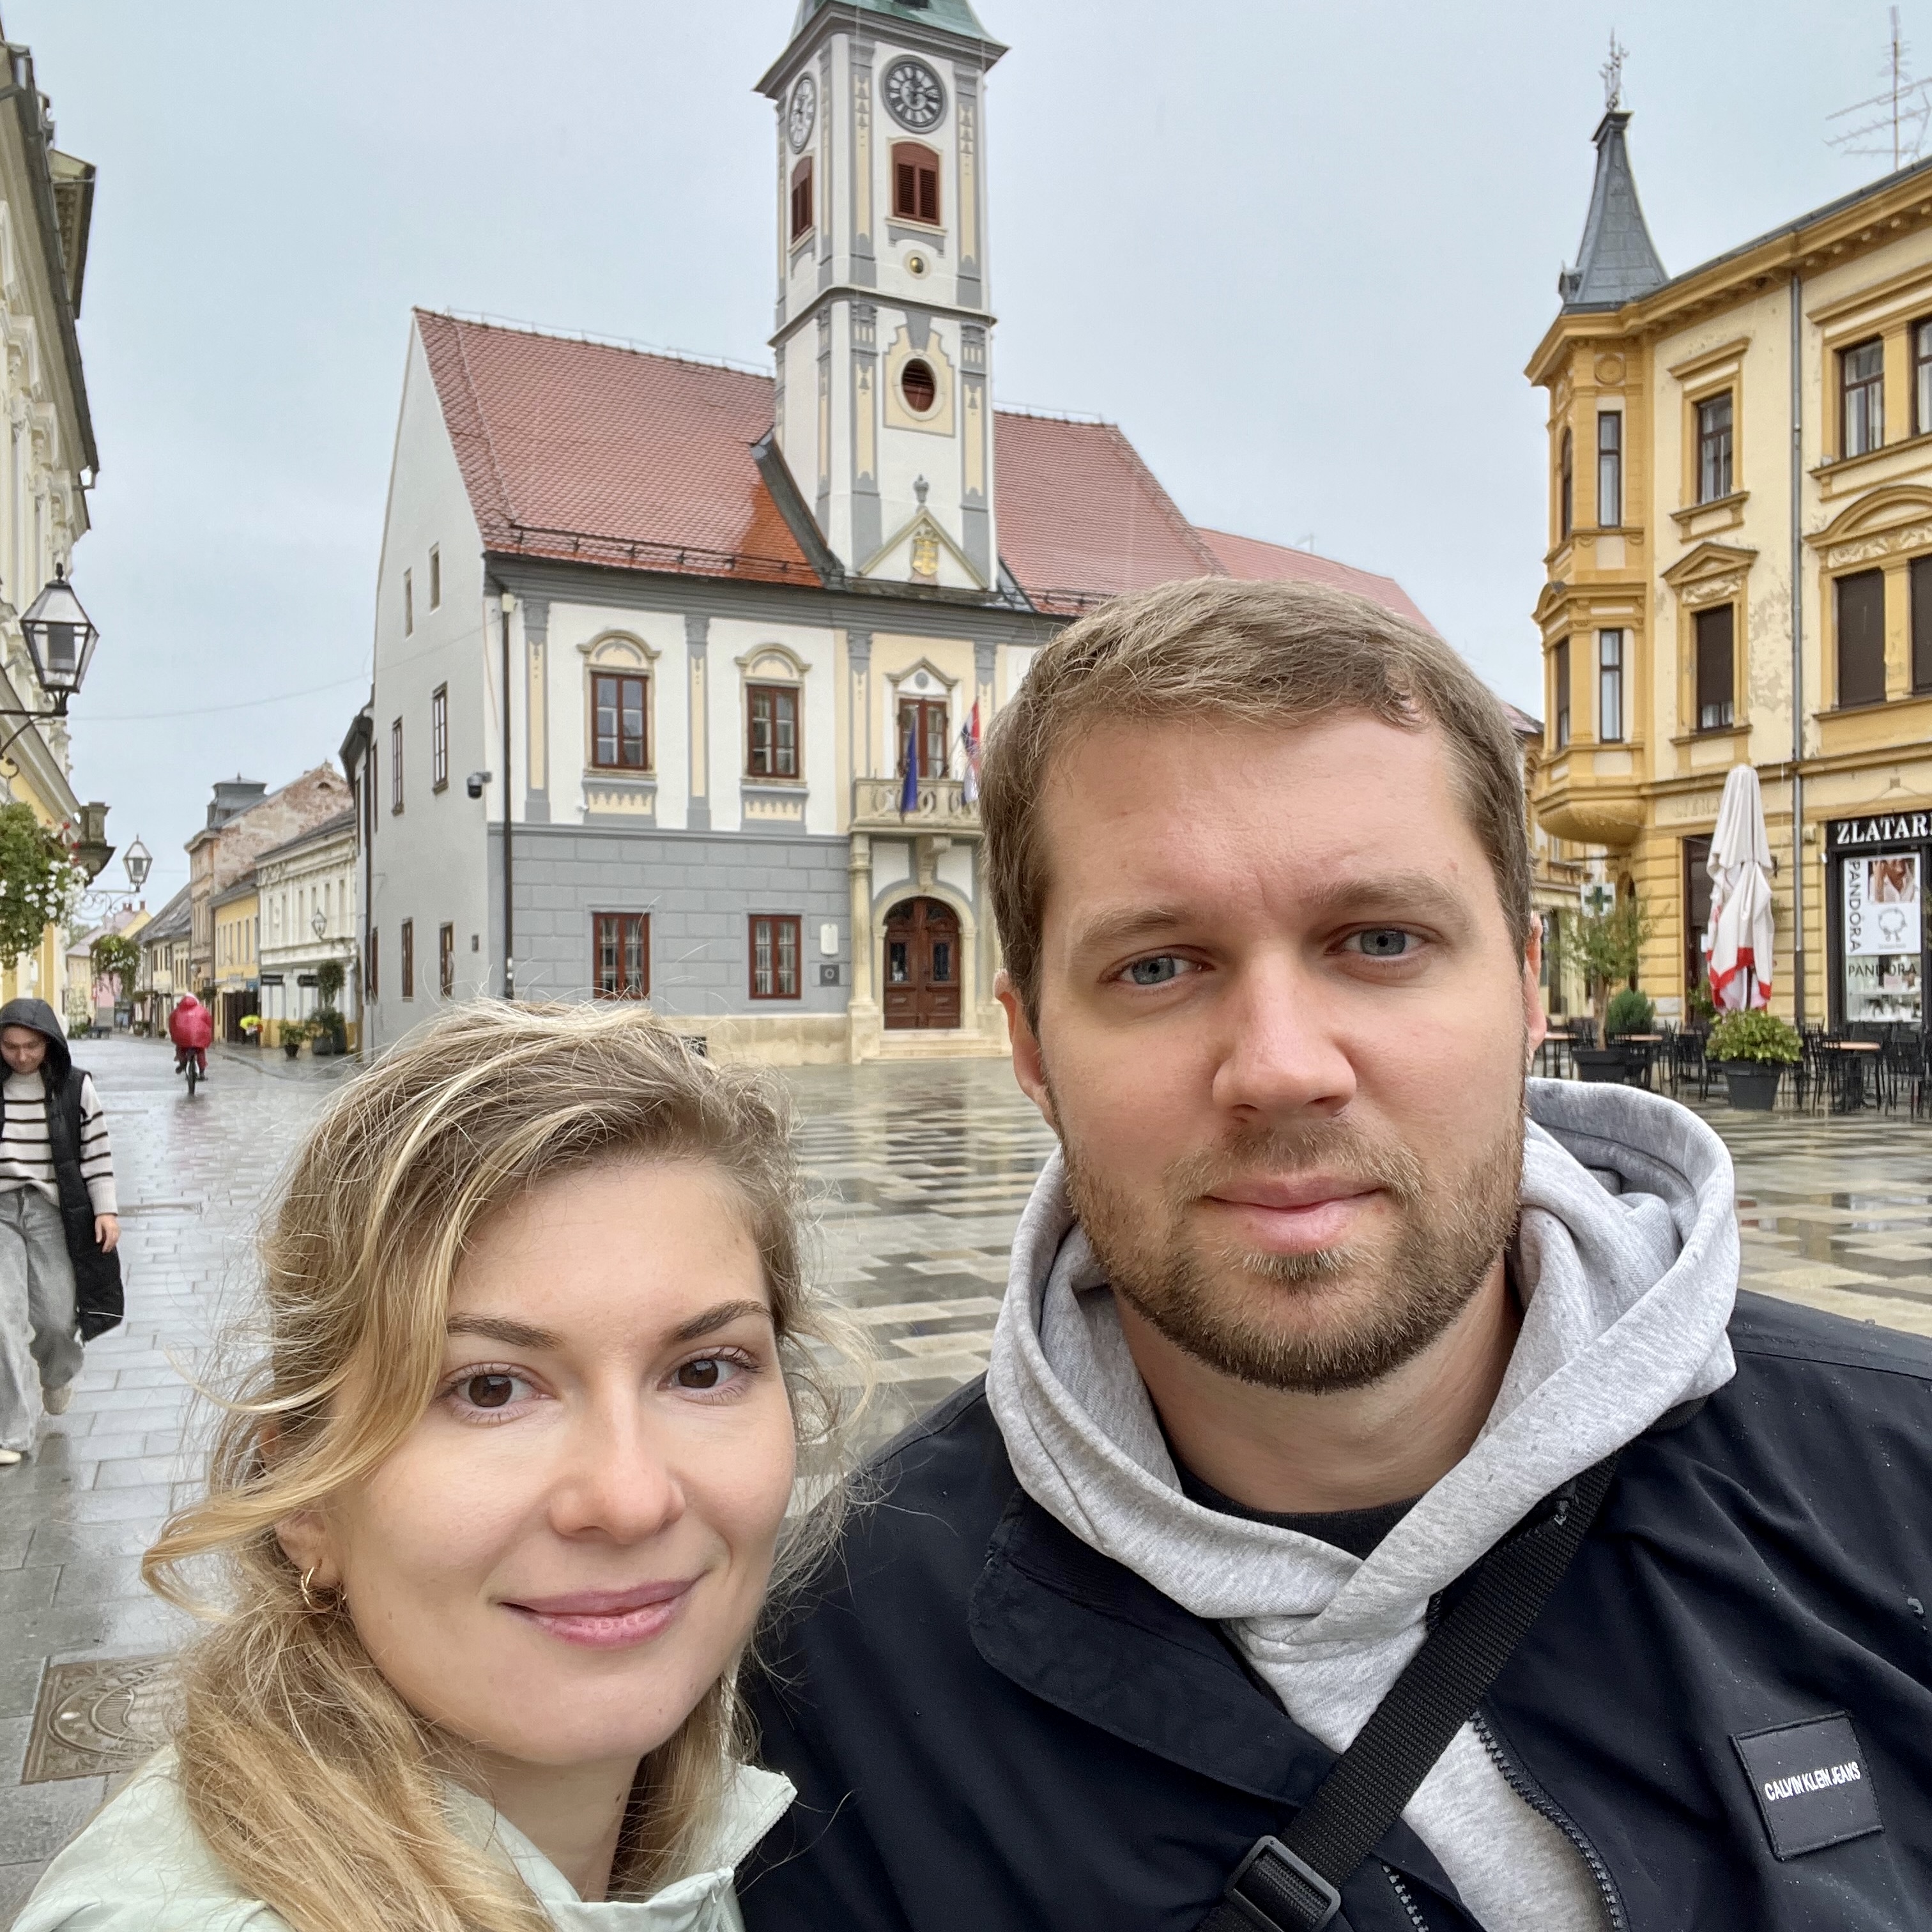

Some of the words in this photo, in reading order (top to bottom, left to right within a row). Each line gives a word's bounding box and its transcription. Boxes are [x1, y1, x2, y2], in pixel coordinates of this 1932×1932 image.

[1837, 813, 1932, 845] ZLATAR
[1849, 860, 1862, 953] PANDORA
[1848, 963, 1917, 977] PANDORA
[1765, 1775, 1805, 1801] CALVIN
[1801, 1768, 1833, 1792] KLEIN
[1831, 1761, 1862, 1785] JEANS
